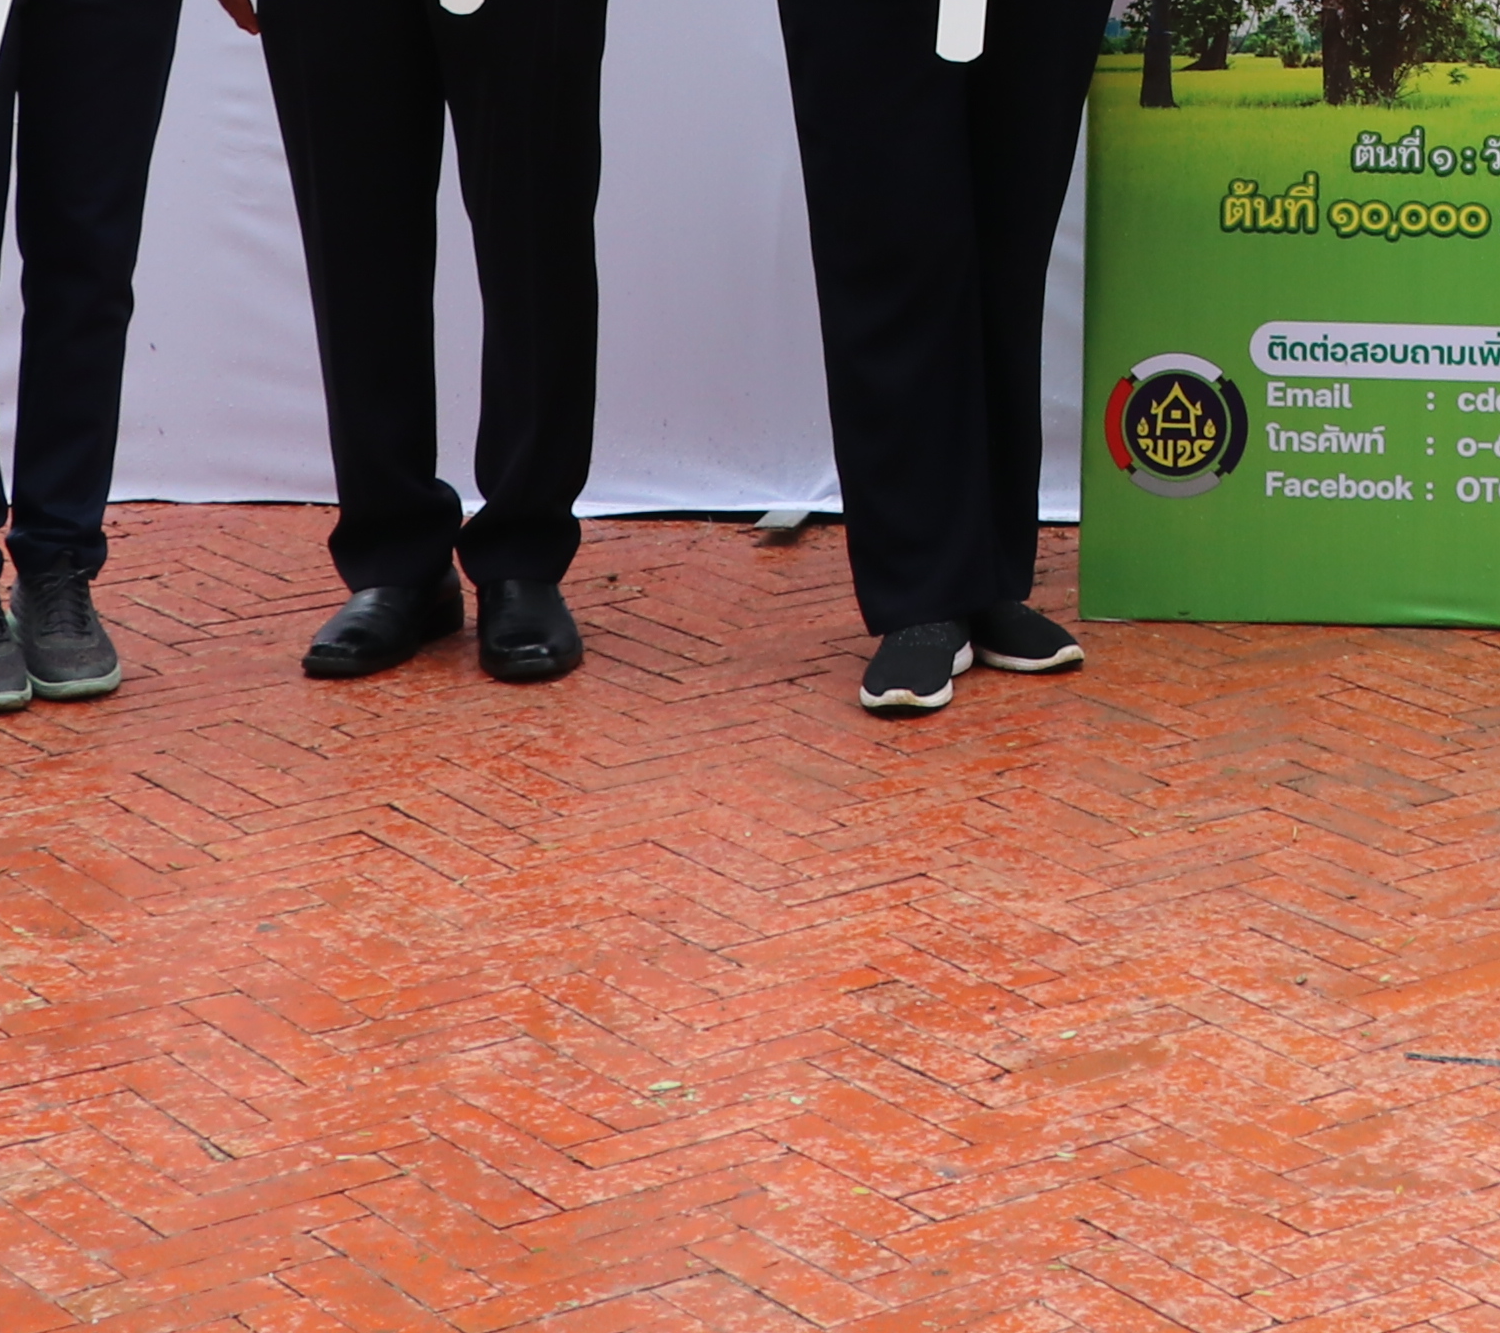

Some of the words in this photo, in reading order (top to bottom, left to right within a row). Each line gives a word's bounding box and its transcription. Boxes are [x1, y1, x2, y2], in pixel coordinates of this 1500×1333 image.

[1352, 126, 1423, 171] ต้นที่
[1430, 149, 1455, 175] ๑
[1220, 173, 1317, 236] ต้นที่
[1328, 192, 1490, 239] ๑๐,๐๐๐
[1266, 382, 1352, 409] Email
[1266, 423, 1385, 455] โทรศัพท์
[1266, 472, 1413, 500] Facebook
